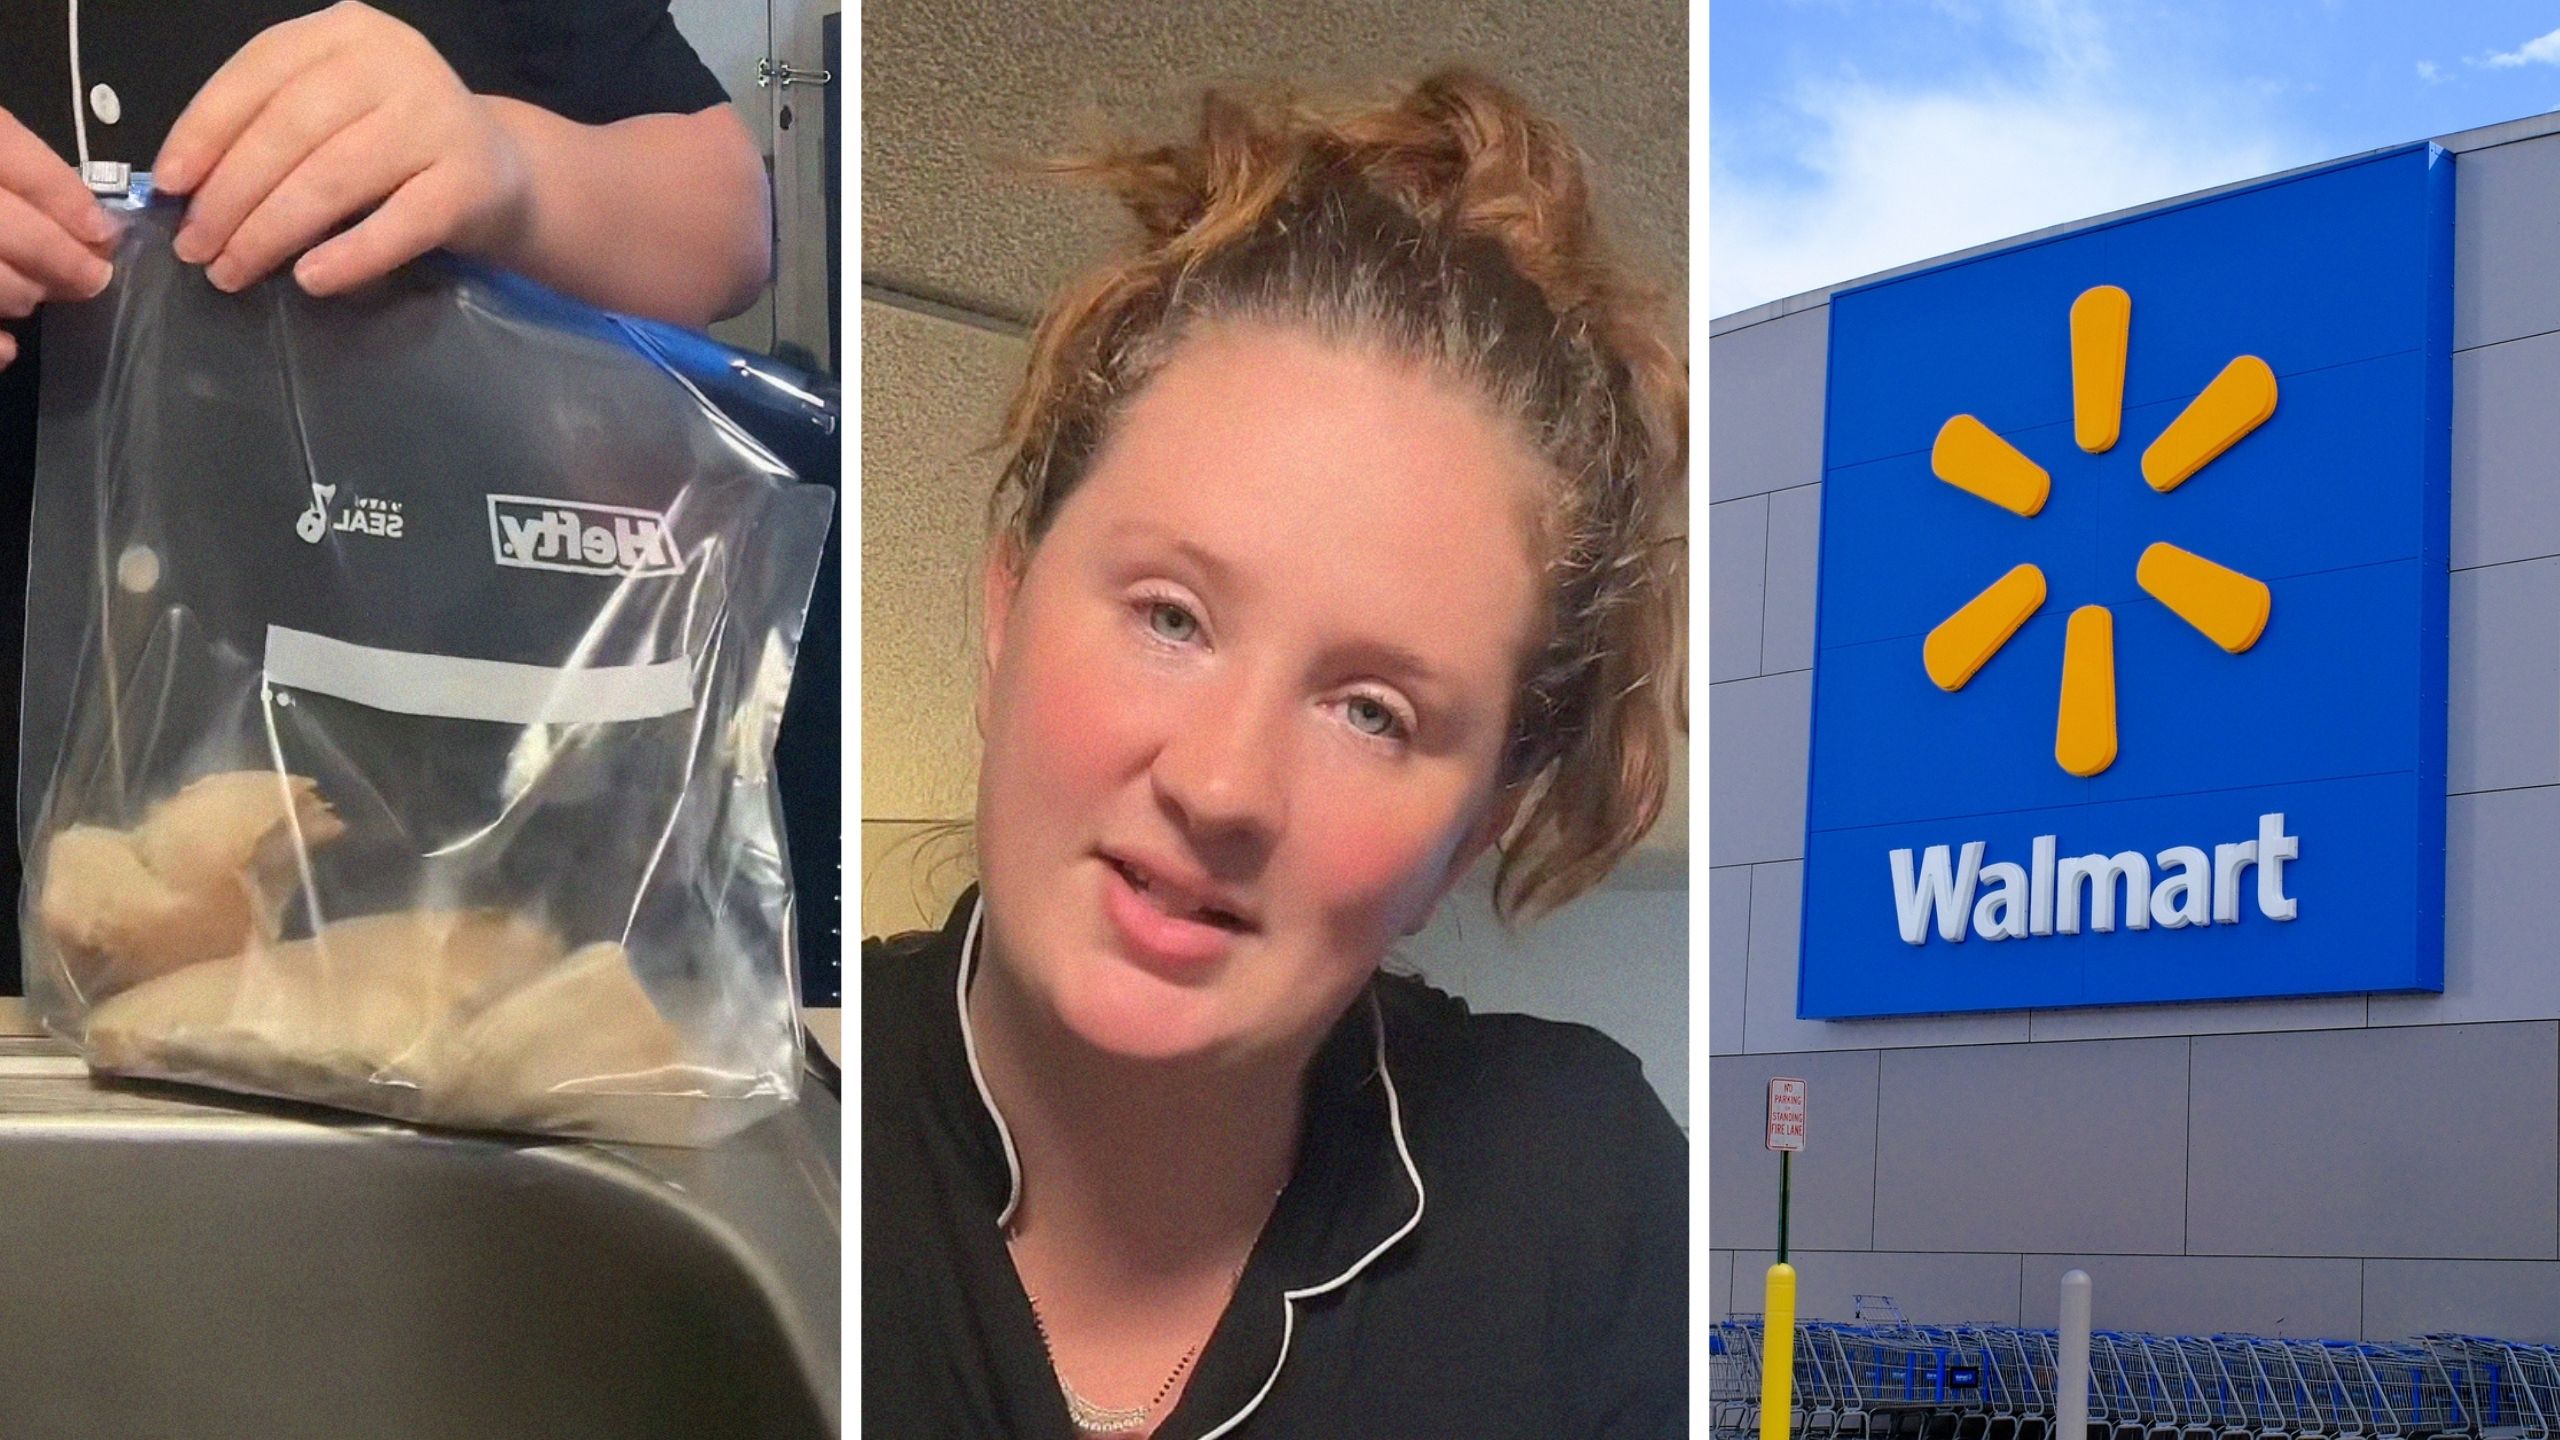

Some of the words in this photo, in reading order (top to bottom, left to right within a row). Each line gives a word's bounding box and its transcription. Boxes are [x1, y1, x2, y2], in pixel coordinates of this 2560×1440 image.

[1889, 812, 2299, 945] Walmart
[1784, 1083, 1793, 1093] NO
[1774, 1095, 1802, 1105] PARKING
[1772, 1112, 1803, 1123] STANDING
[1771, 1123, 1785, 1135] FIRE
[1786, 1124, 1803, 1137] LANE
